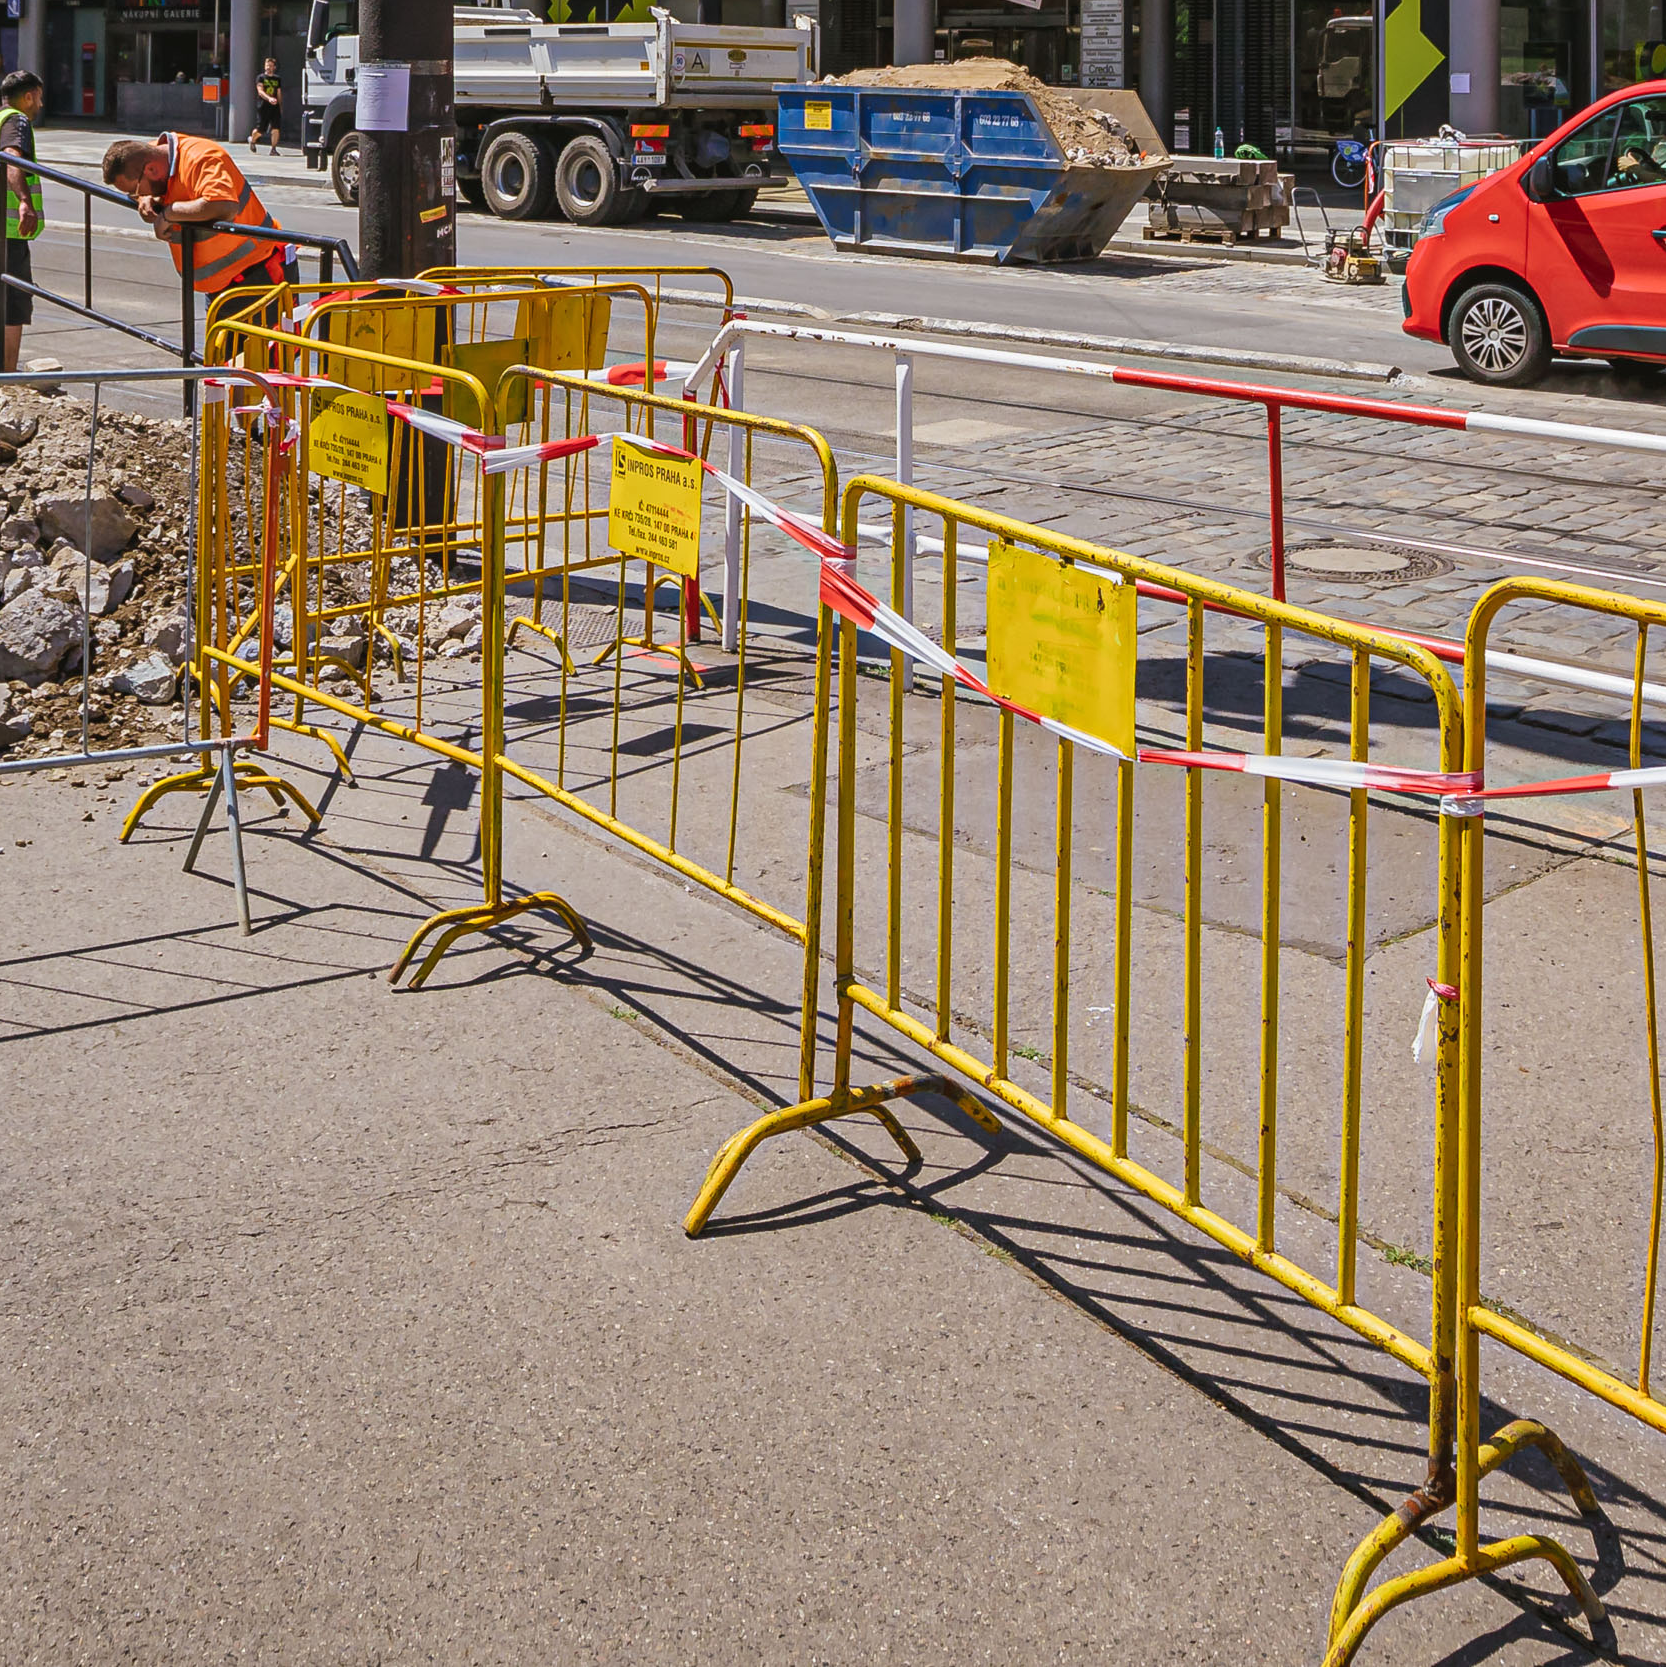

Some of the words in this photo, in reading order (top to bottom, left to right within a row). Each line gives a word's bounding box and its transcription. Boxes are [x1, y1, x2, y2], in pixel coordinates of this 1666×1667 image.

[163, 8, 201, 19] GALERIE
[691, 52, 704, 69] A
[992, 115, 1000, 126] 22
[1001, 115, 1010, 127] 77
[346, 405, 368, 421] PRAHA
[627, 458, 654, 479] INPROS
[656, 466, 681, 487] PRAHA
[682, 475, 698, 491] a.s.
[646, 503, 669, 519] 47114444
[614, 508, 621, 518] KE
[654, 520, 663, 531] 147
[663, 523, 670, 534] 00
[671, 525, 689, 539] PRAHA
[648, 532, 657, 542] 244
[658, 536, 668, 547] 463
[668, 538, 678, 550] 581
